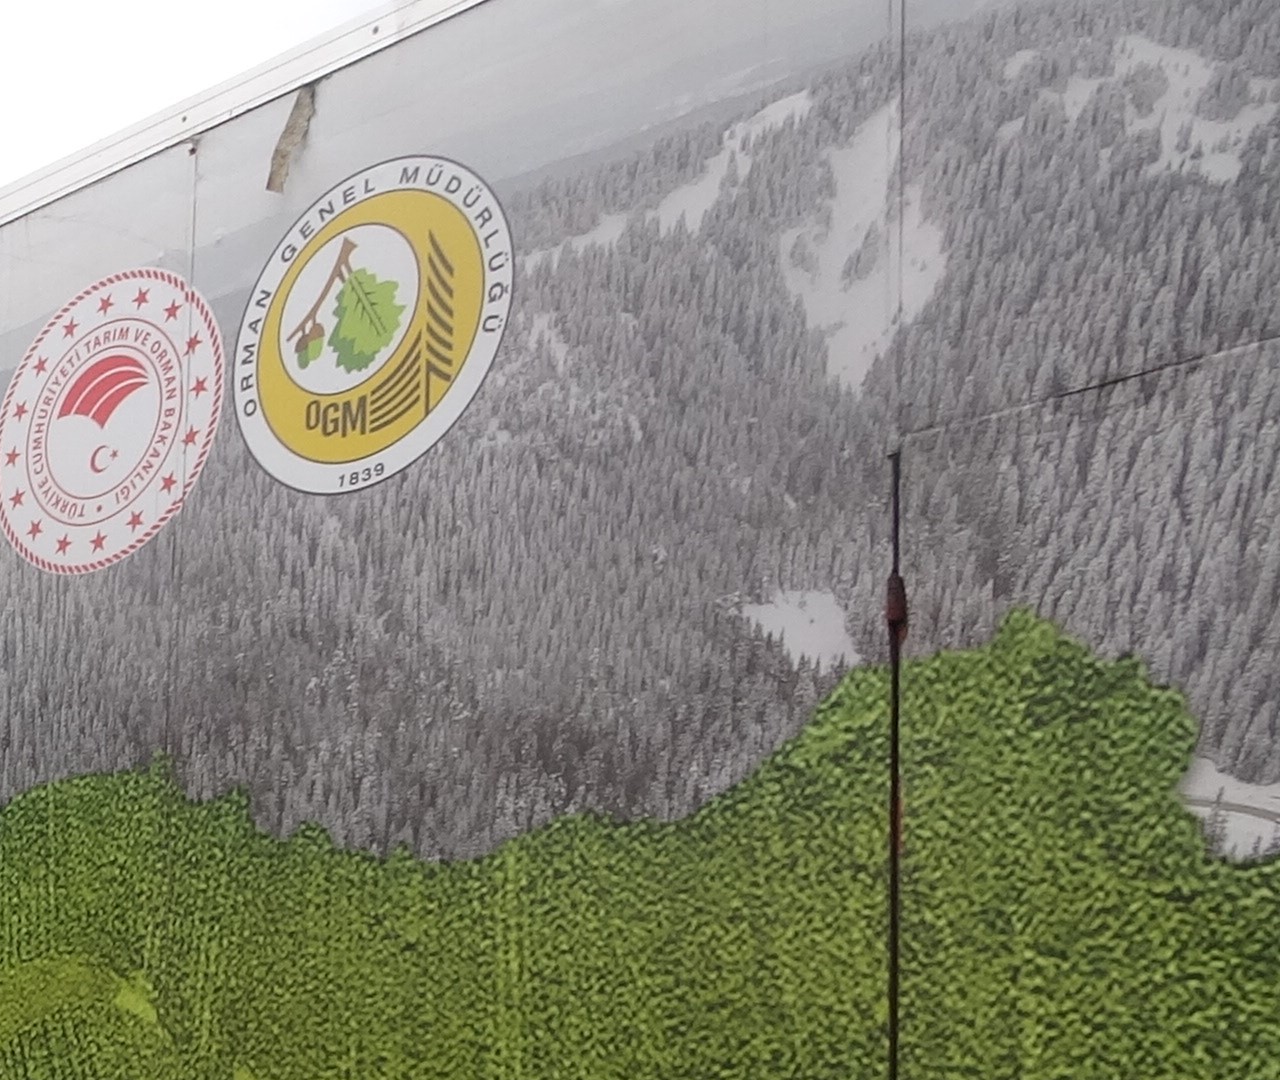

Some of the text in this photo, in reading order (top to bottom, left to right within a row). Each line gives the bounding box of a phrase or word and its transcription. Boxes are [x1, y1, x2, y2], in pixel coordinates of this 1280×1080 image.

[242, 164, 512, 417] ORMAN GENEL MÜDÜRLÜĞÜ
[83, 326, 130, 350] TARIM
[134, 329, 152, 347] VE
[150, 340, 178, 401] ORMAN
[305, 400, 368, 438] OGM
[114, 407, 176, 505] BAKANLIĞI
[336, 462, 386, 488] 1839
